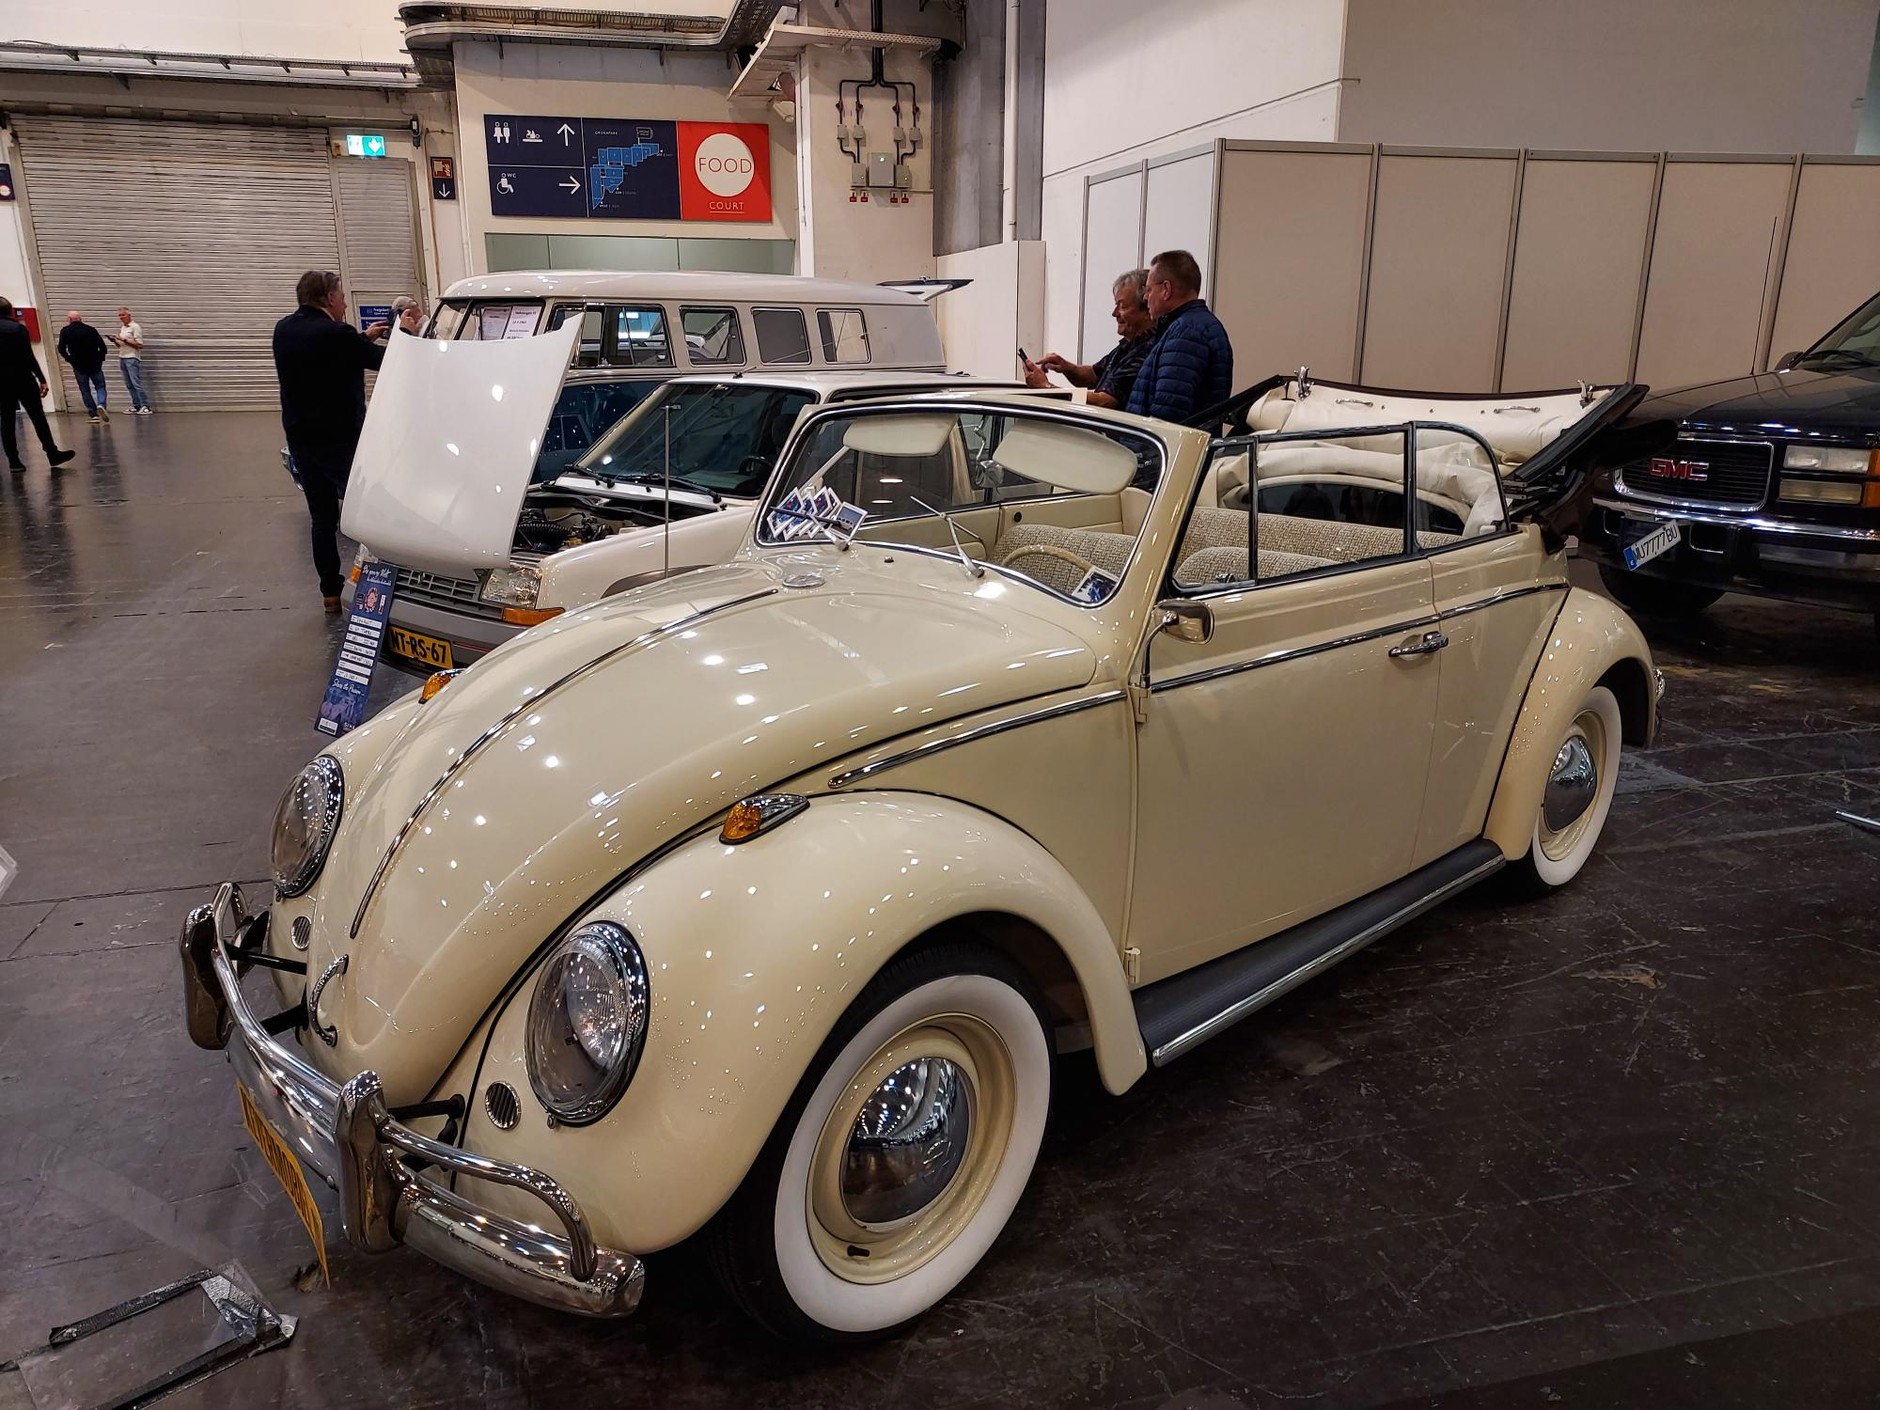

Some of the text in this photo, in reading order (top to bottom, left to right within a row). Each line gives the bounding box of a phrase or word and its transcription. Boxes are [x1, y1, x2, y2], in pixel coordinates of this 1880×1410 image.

[698, 157, 753, 173] FOOD
[709, 201, 745, 211] COURT
[1651, 458, 1709, 482] GMC
